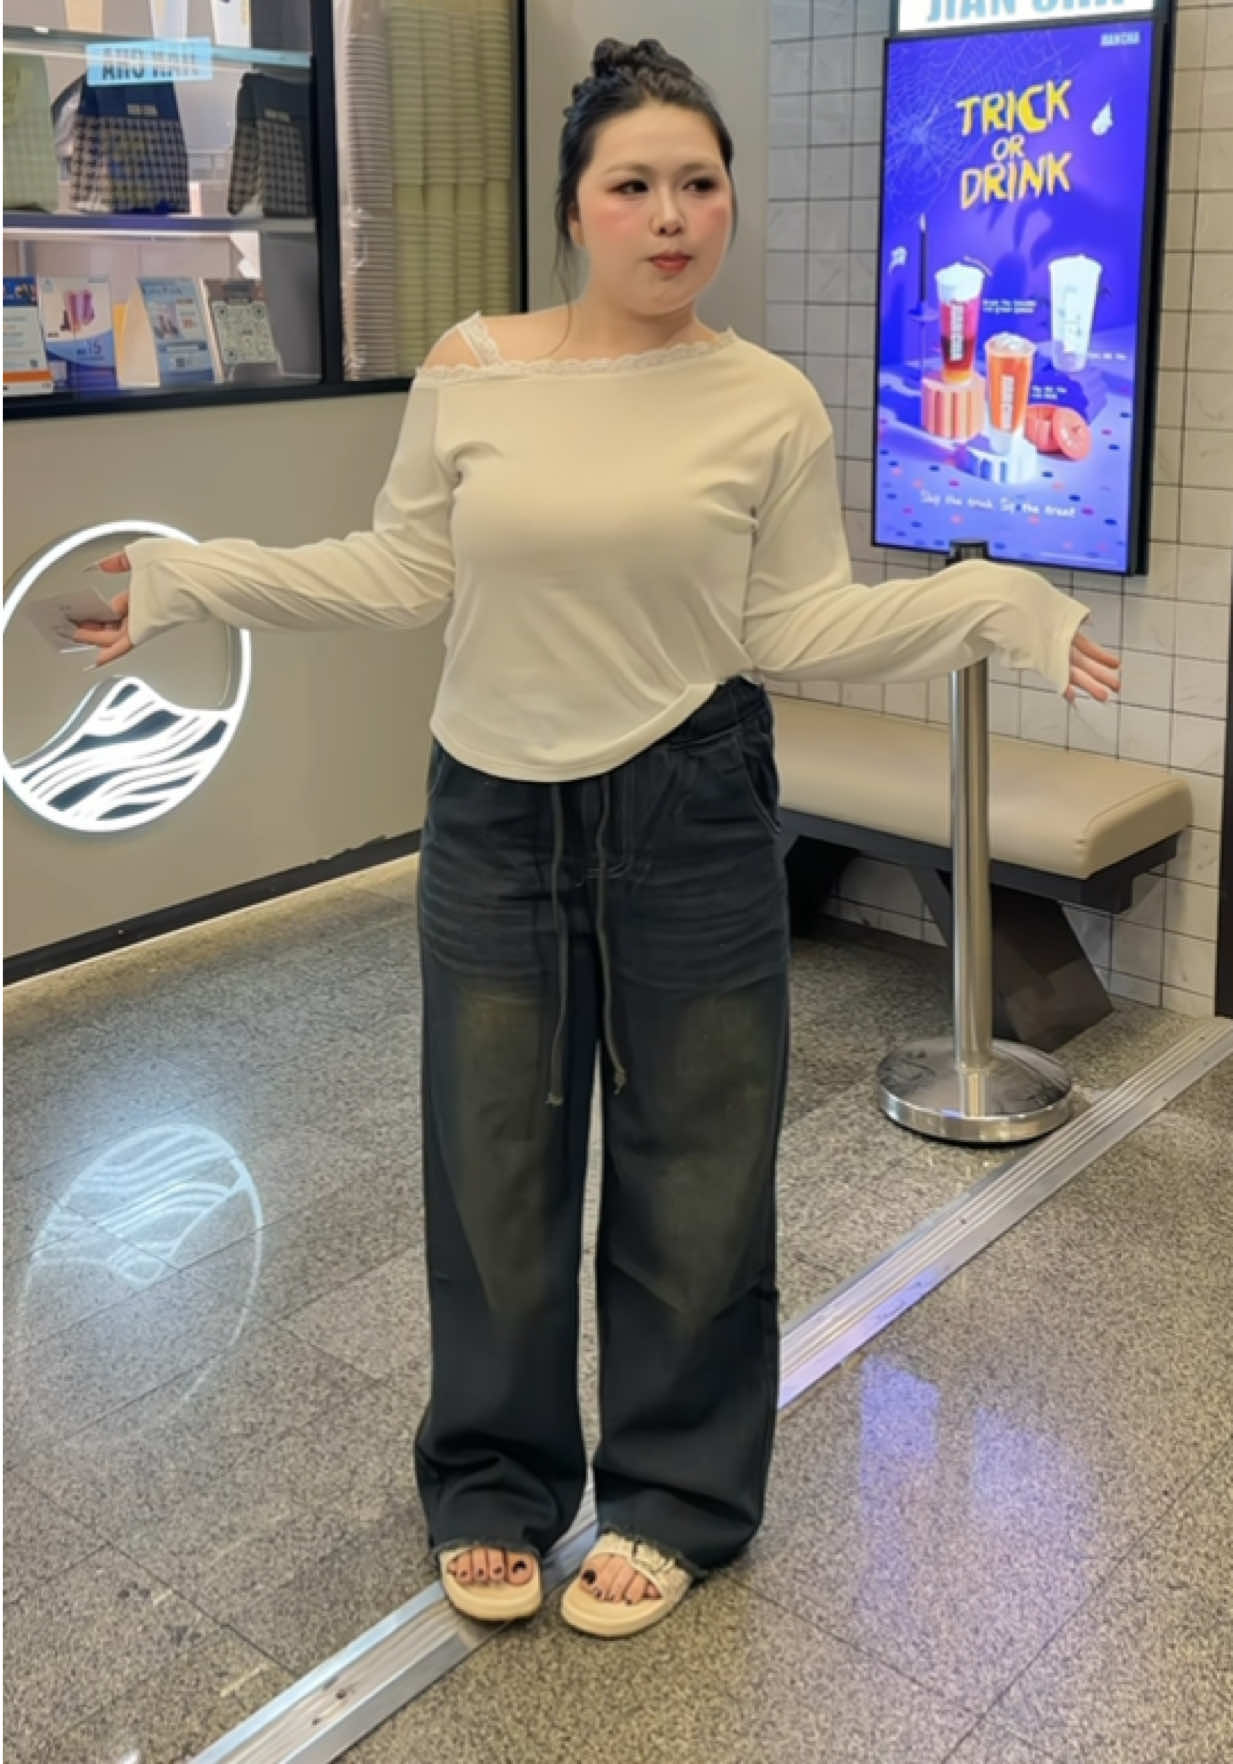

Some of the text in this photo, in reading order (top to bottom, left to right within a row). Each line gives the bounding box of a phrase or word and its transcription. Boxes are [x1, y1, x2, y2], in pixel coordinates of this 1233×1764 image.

[955, 79, 1072, 137] TRICK
[992, 134, 1025, 162] OR
[961, 152, 1073, 210] DRINK
